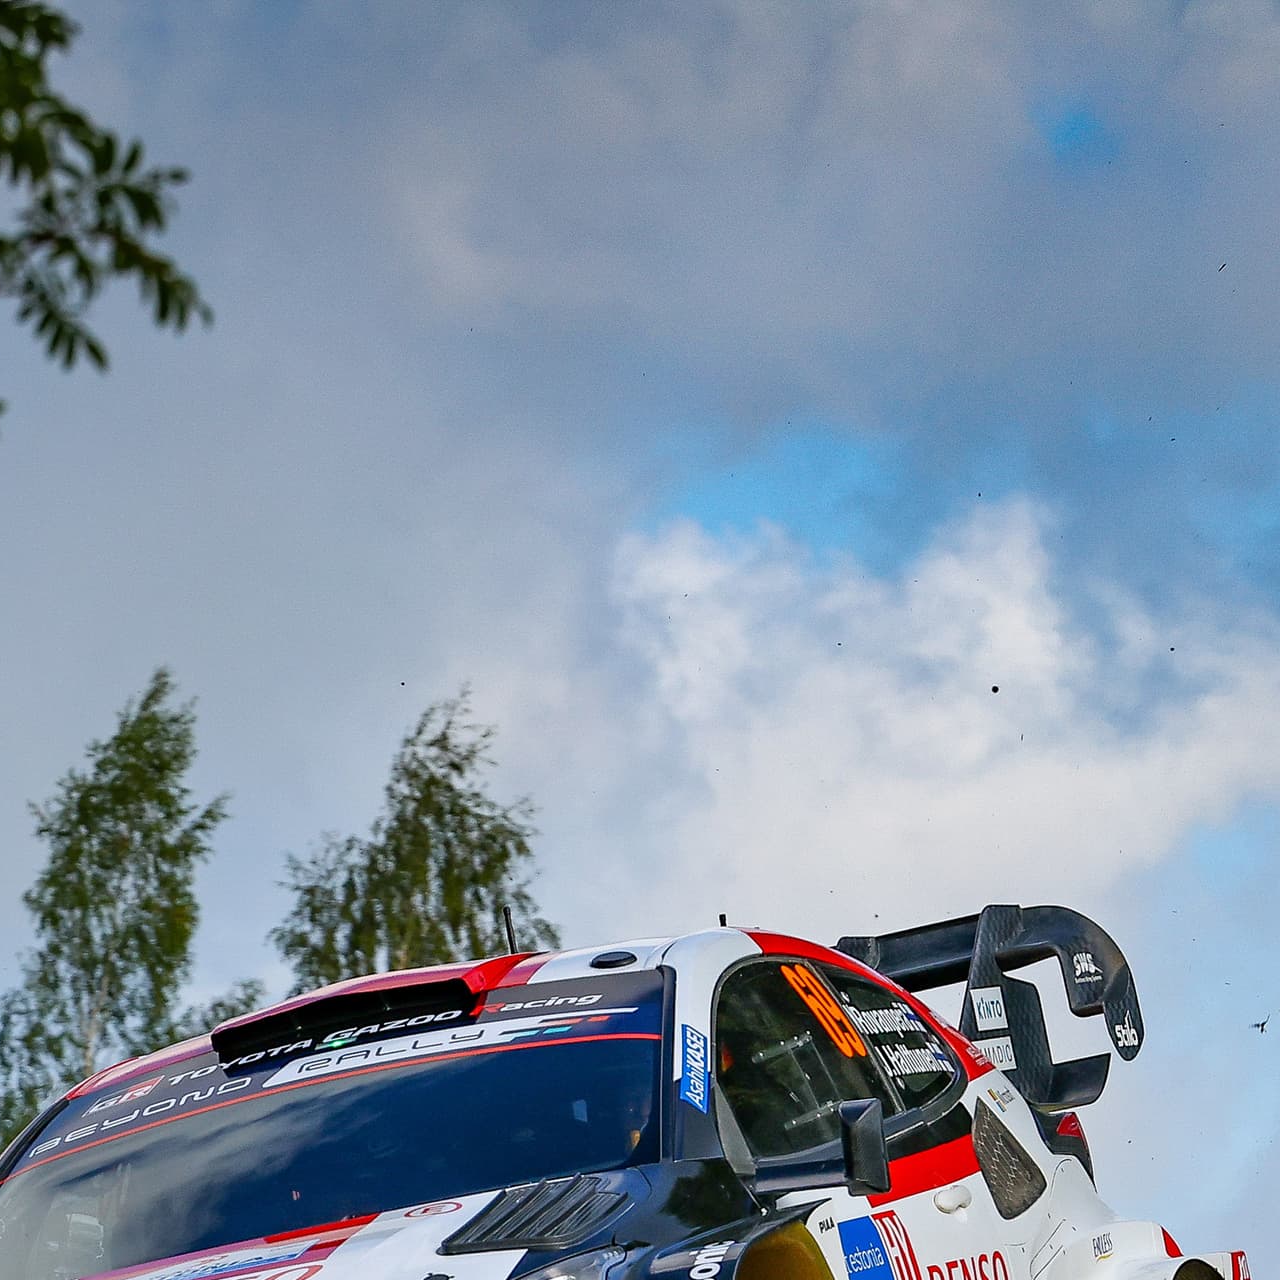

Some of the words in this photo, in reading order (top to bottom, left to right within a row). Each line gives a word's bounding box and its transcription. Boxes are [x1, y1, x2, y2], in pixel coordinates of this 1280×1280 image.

[169, 1038, 313, 1086] TOYOTA
[322, 1009, 463, 1043] GAZOO
[470, 993, 603, 1016] Racing
[780, 963, 867, 1058] 69
[28, 1077, 252, 1158] BEYOND
[297, 1029, 485, 1074] RALLY
[850, 1243, 885, 1272] estonia
